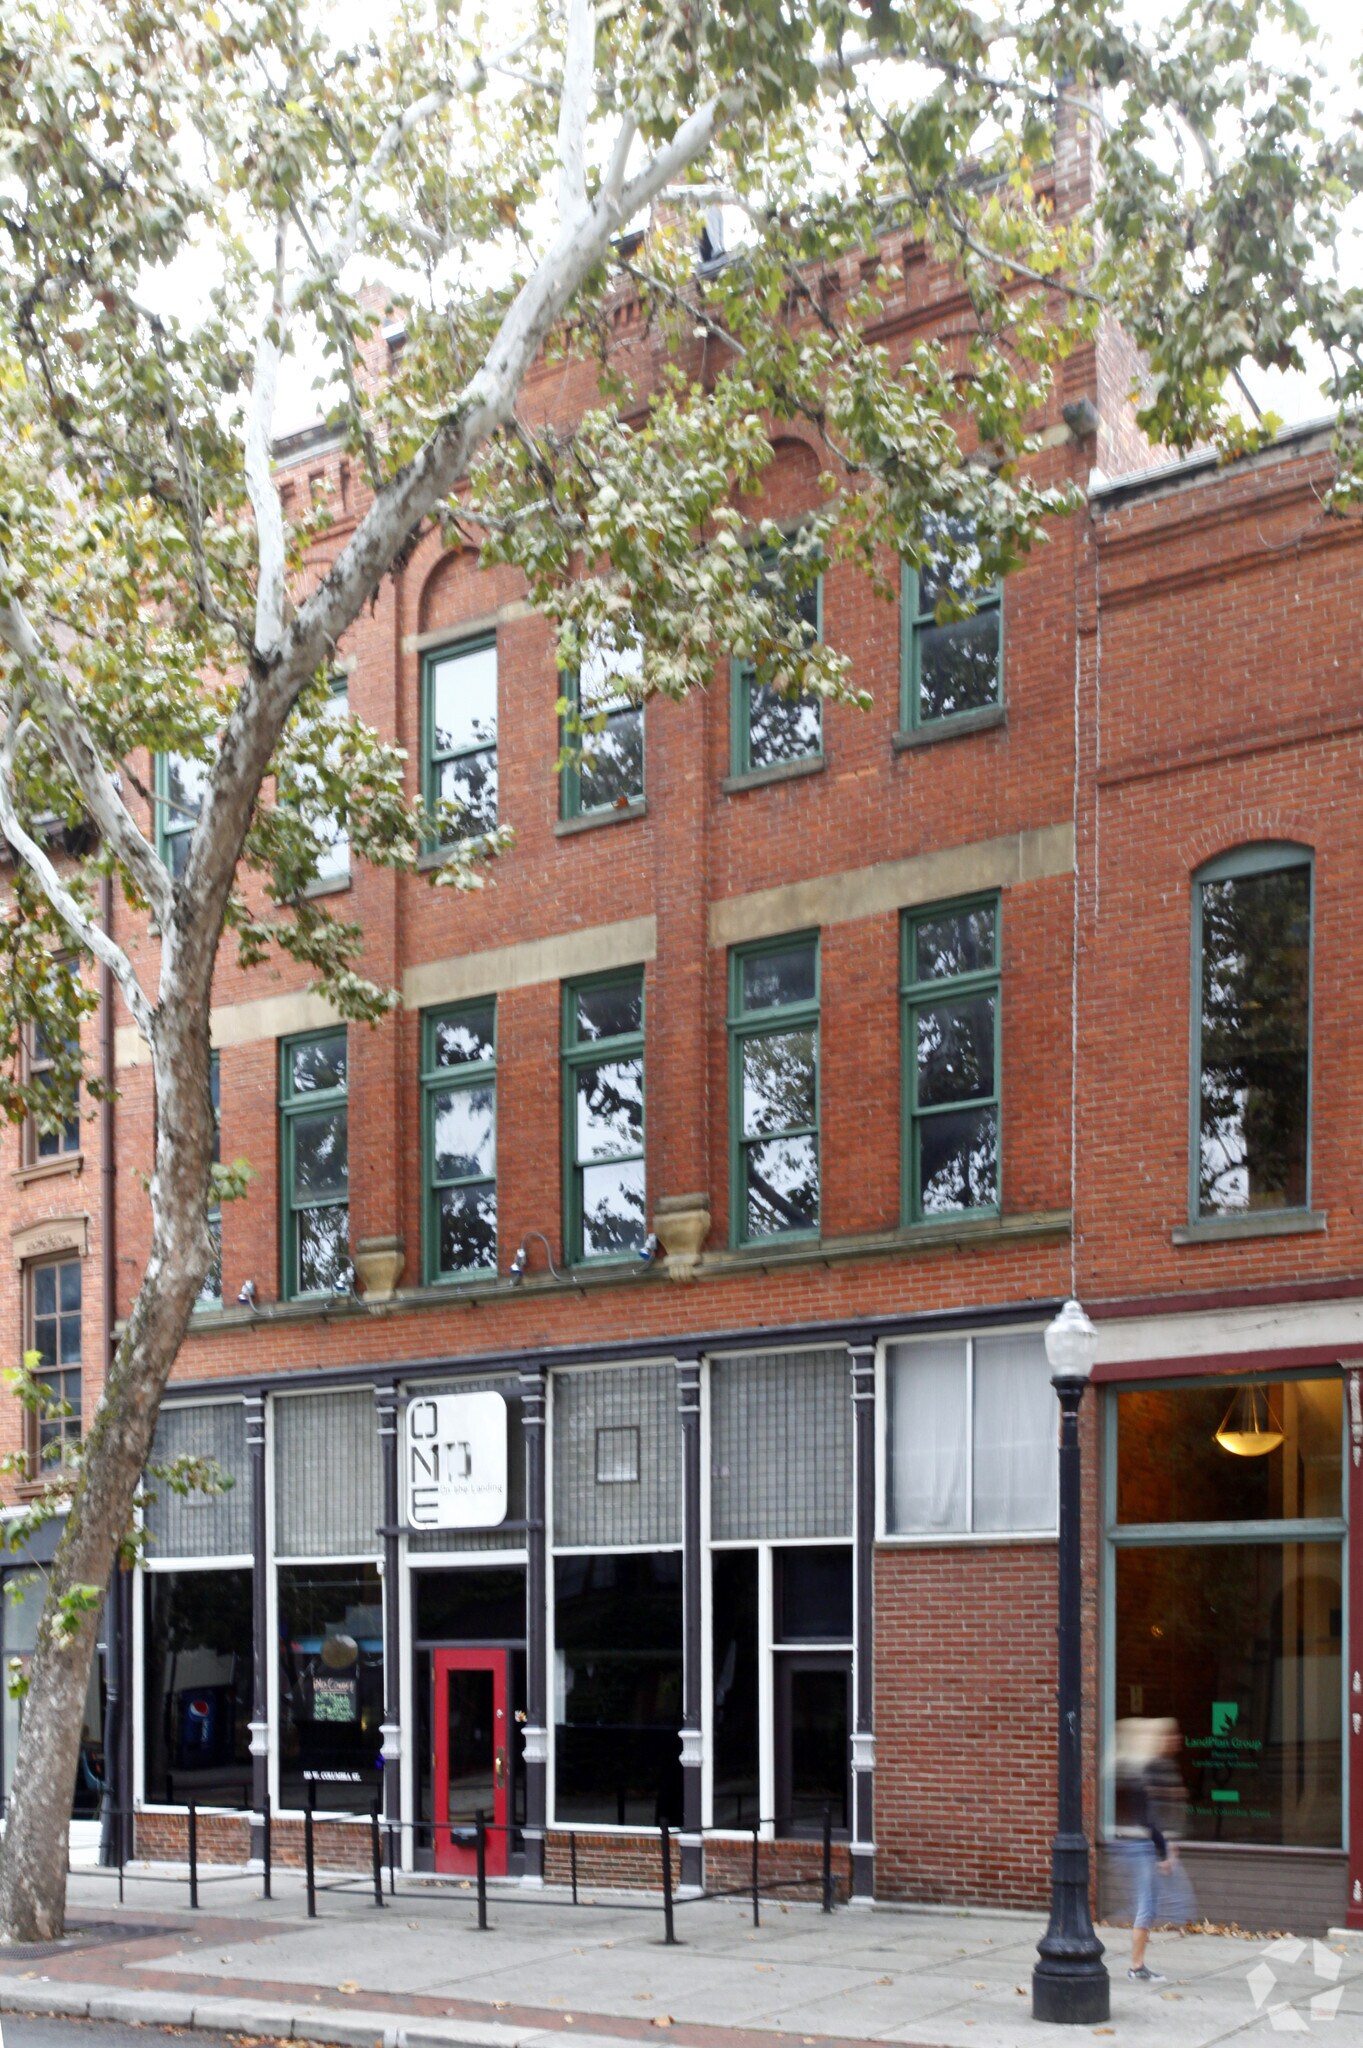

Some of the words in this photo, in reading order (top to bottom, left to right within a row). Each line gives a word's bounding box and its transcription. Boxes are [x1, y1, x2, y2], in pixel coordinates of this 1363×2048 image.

[411, 1401, 439, 1523] ONE
[1185, 1736, 1230, 1748] LandPlan
[1232, 1737, 1262, 1751] Group
[321, 1771, 352, 1782] COLUMBIA
